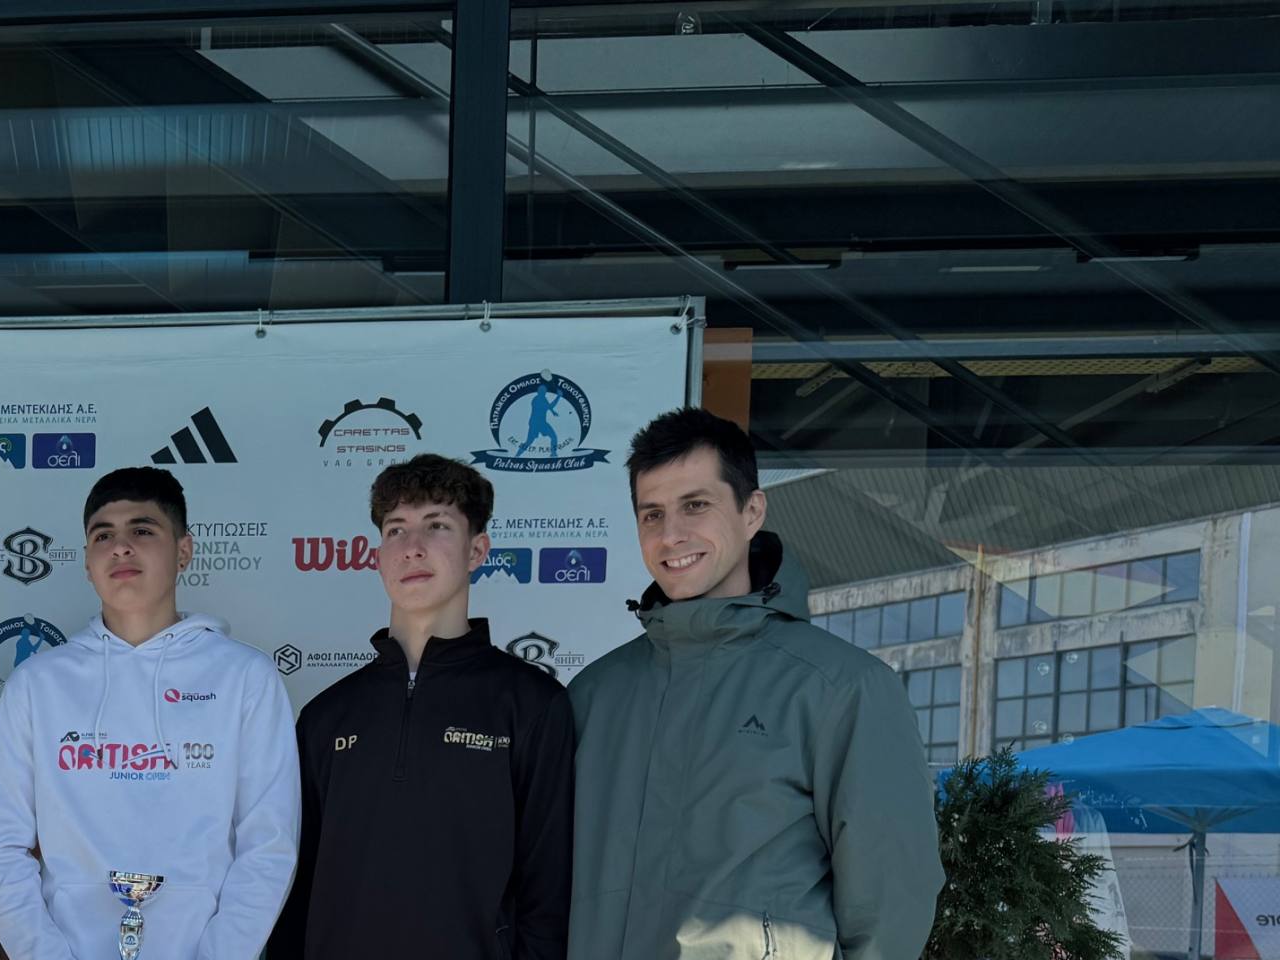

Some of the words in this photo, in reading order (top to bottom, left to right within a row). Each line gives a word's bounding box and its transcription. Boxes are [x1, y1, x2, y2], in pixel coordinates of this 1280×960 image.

[0, 404, 73, 415] ΜΕΝΤΕΚΙΔΗΣ
[76, 404, 97, 414] Α.Ε.
[334, 427, 410, 437] CARETTAS
[336, 444, 407, 453] STASINOS
[187, 522, 268, 536] ΚΤΥΠΩΣΕΙΣ
[505, 518, 584, 529] ΜΕΝΤΕΚΙΔΗΣ
[586, 518, 609, 528] Α.Ε.
[292, 535, 381, 571] Wils
[190, 556, 262, 570] ΤΙΝΟΠΟΥ
[183, 742, 215, 760] 100
[109, 771, 144, 780] JUNIOR
